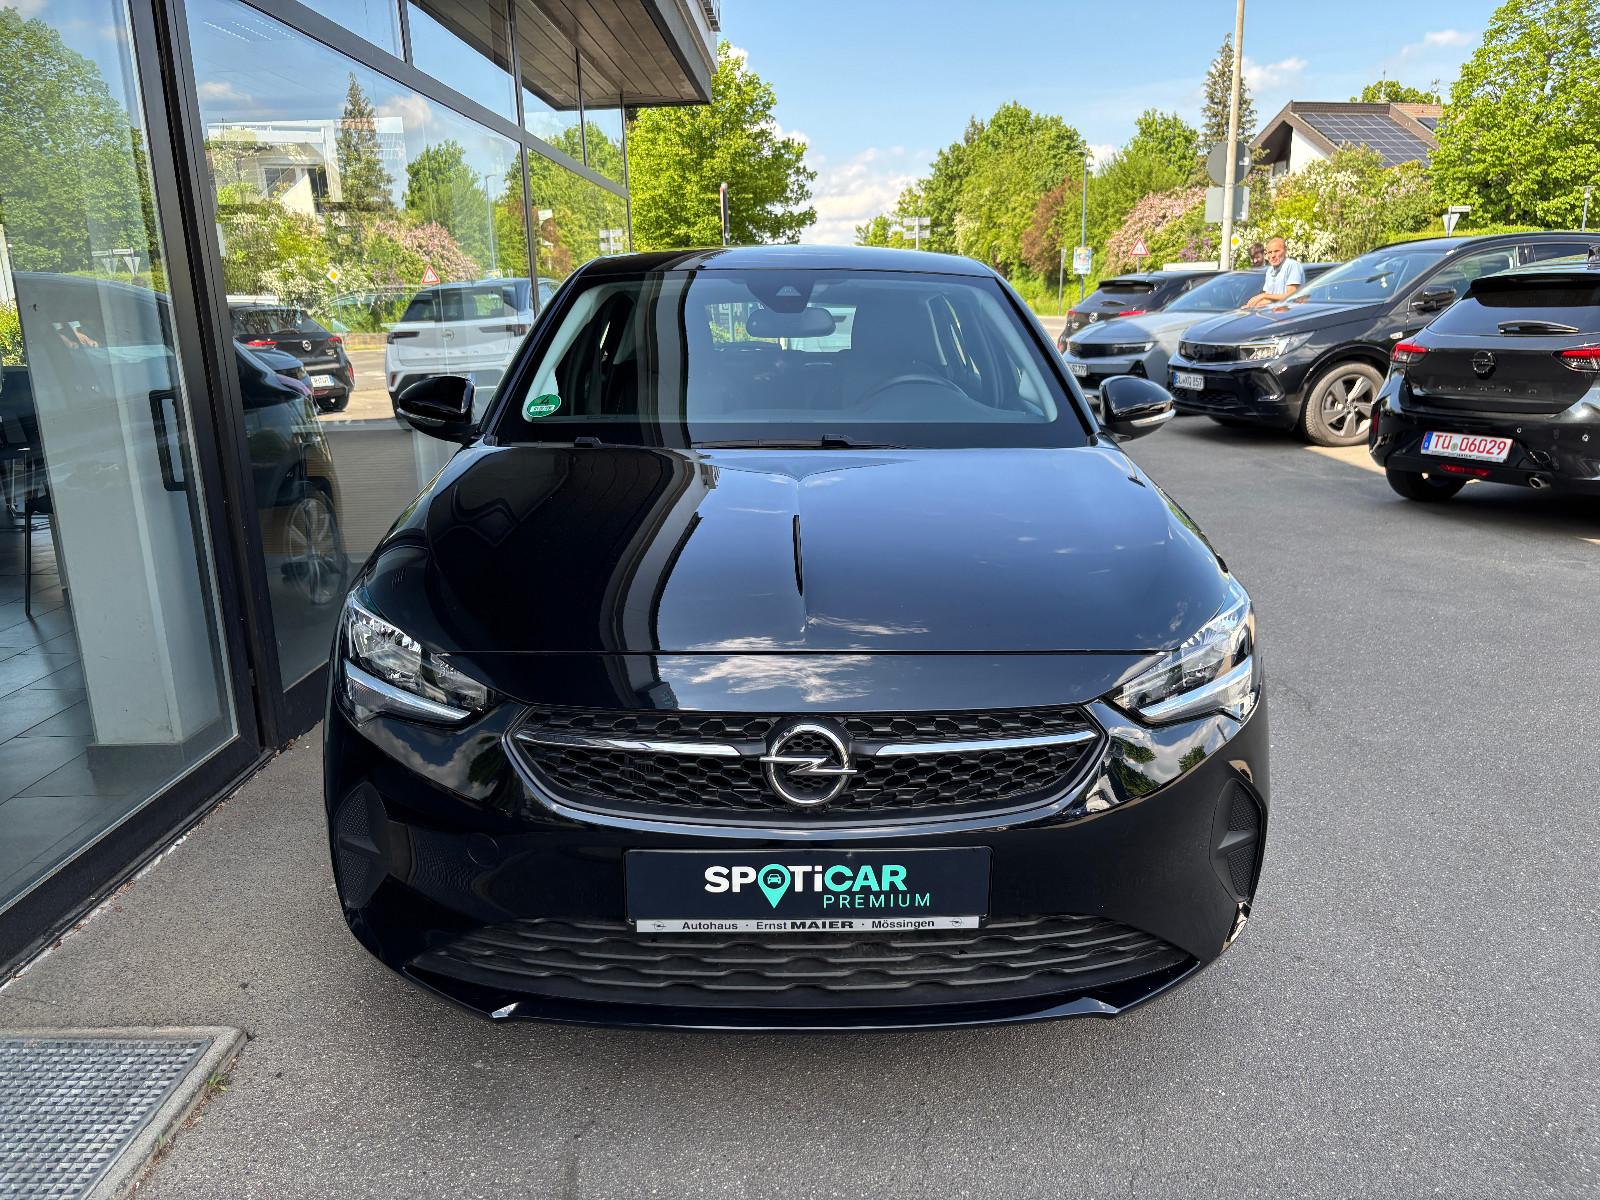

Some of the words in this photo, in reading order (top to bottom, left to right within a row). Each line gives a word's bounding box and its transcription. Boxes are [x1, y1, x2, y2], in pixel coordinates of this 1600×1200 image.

[1459, 437, 1507, 456] 06029
[823, 893, 931, 909] PREMIUM
[682, 921, 738, 930] Autohaus
[756, 921, 787, 930] Ernst
[790, 920, 854, 930] MAIER
[871, 920, 935, 930] Mössingen
